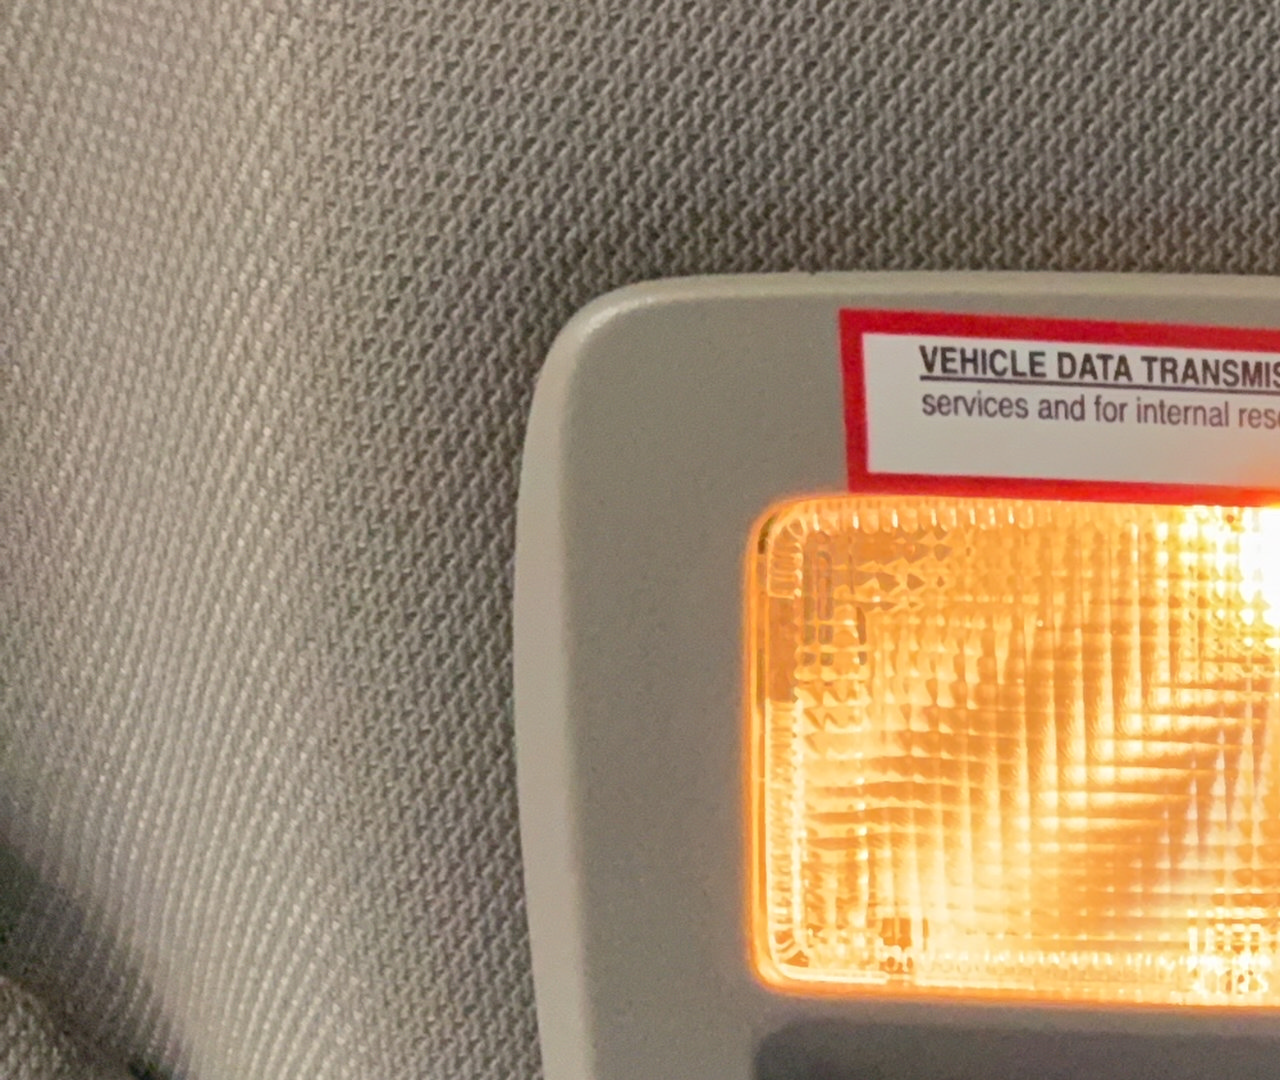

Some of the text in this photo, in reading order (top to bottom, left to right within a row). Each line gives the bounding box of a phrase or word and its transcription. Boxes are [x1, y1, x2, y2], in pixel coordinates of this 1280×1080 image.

[919, 345, 1046, 378] VEHICLE
[1056, 351, 1132, 383] DATA
[922, 392, 1029, 420] services
[1038, 394, 1085, 423] and
[1094, 394, 1128, 424] for
[1137, 396, 1230, 429] internal
